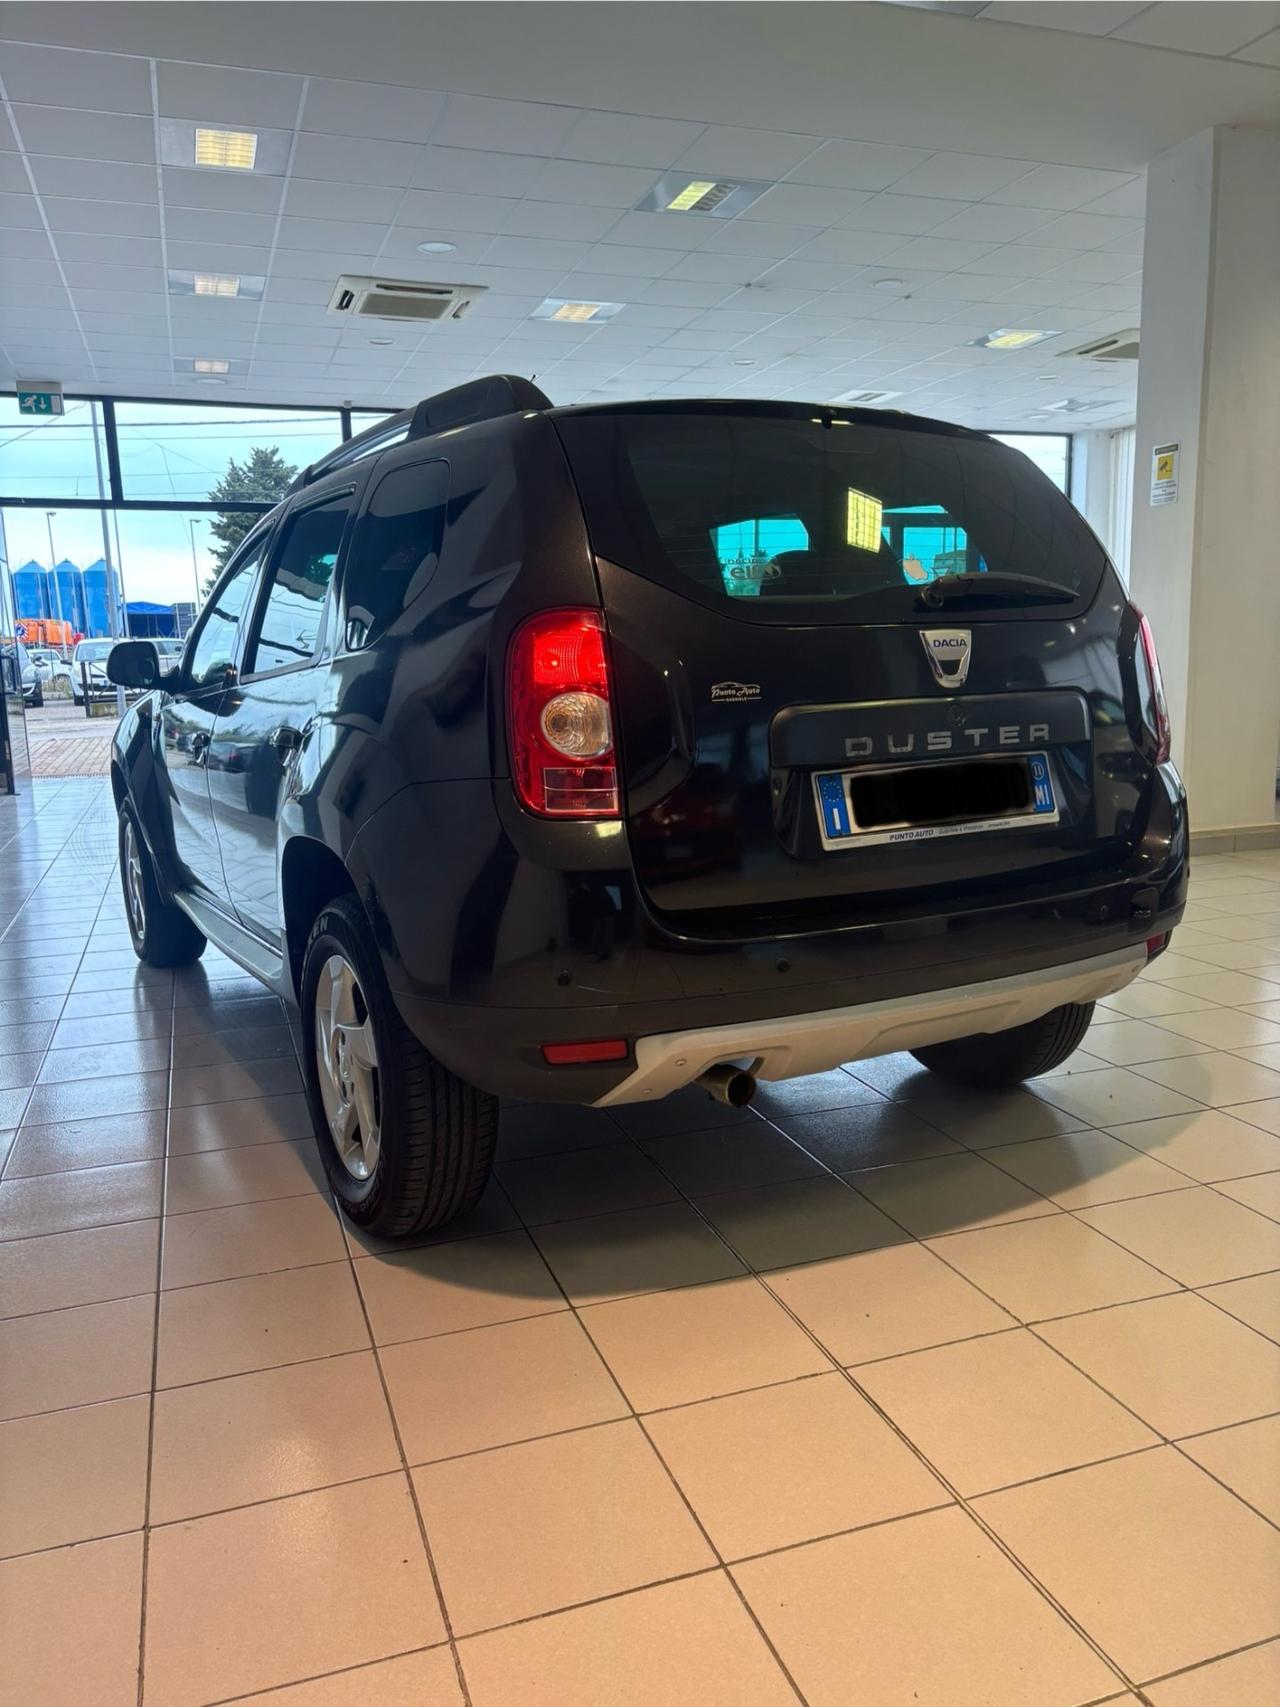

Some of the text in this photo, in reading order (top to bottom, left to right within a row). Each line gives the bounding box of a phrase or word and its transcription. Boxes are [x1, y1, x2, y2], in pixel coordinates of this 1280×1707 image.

[932, 638, 968, 648] DACIA
[711, 688, 736, 698] Punto
[845, 723, 1051, 758] DUSTER
[889, 829, 934, 842] PUNTO AUTO
